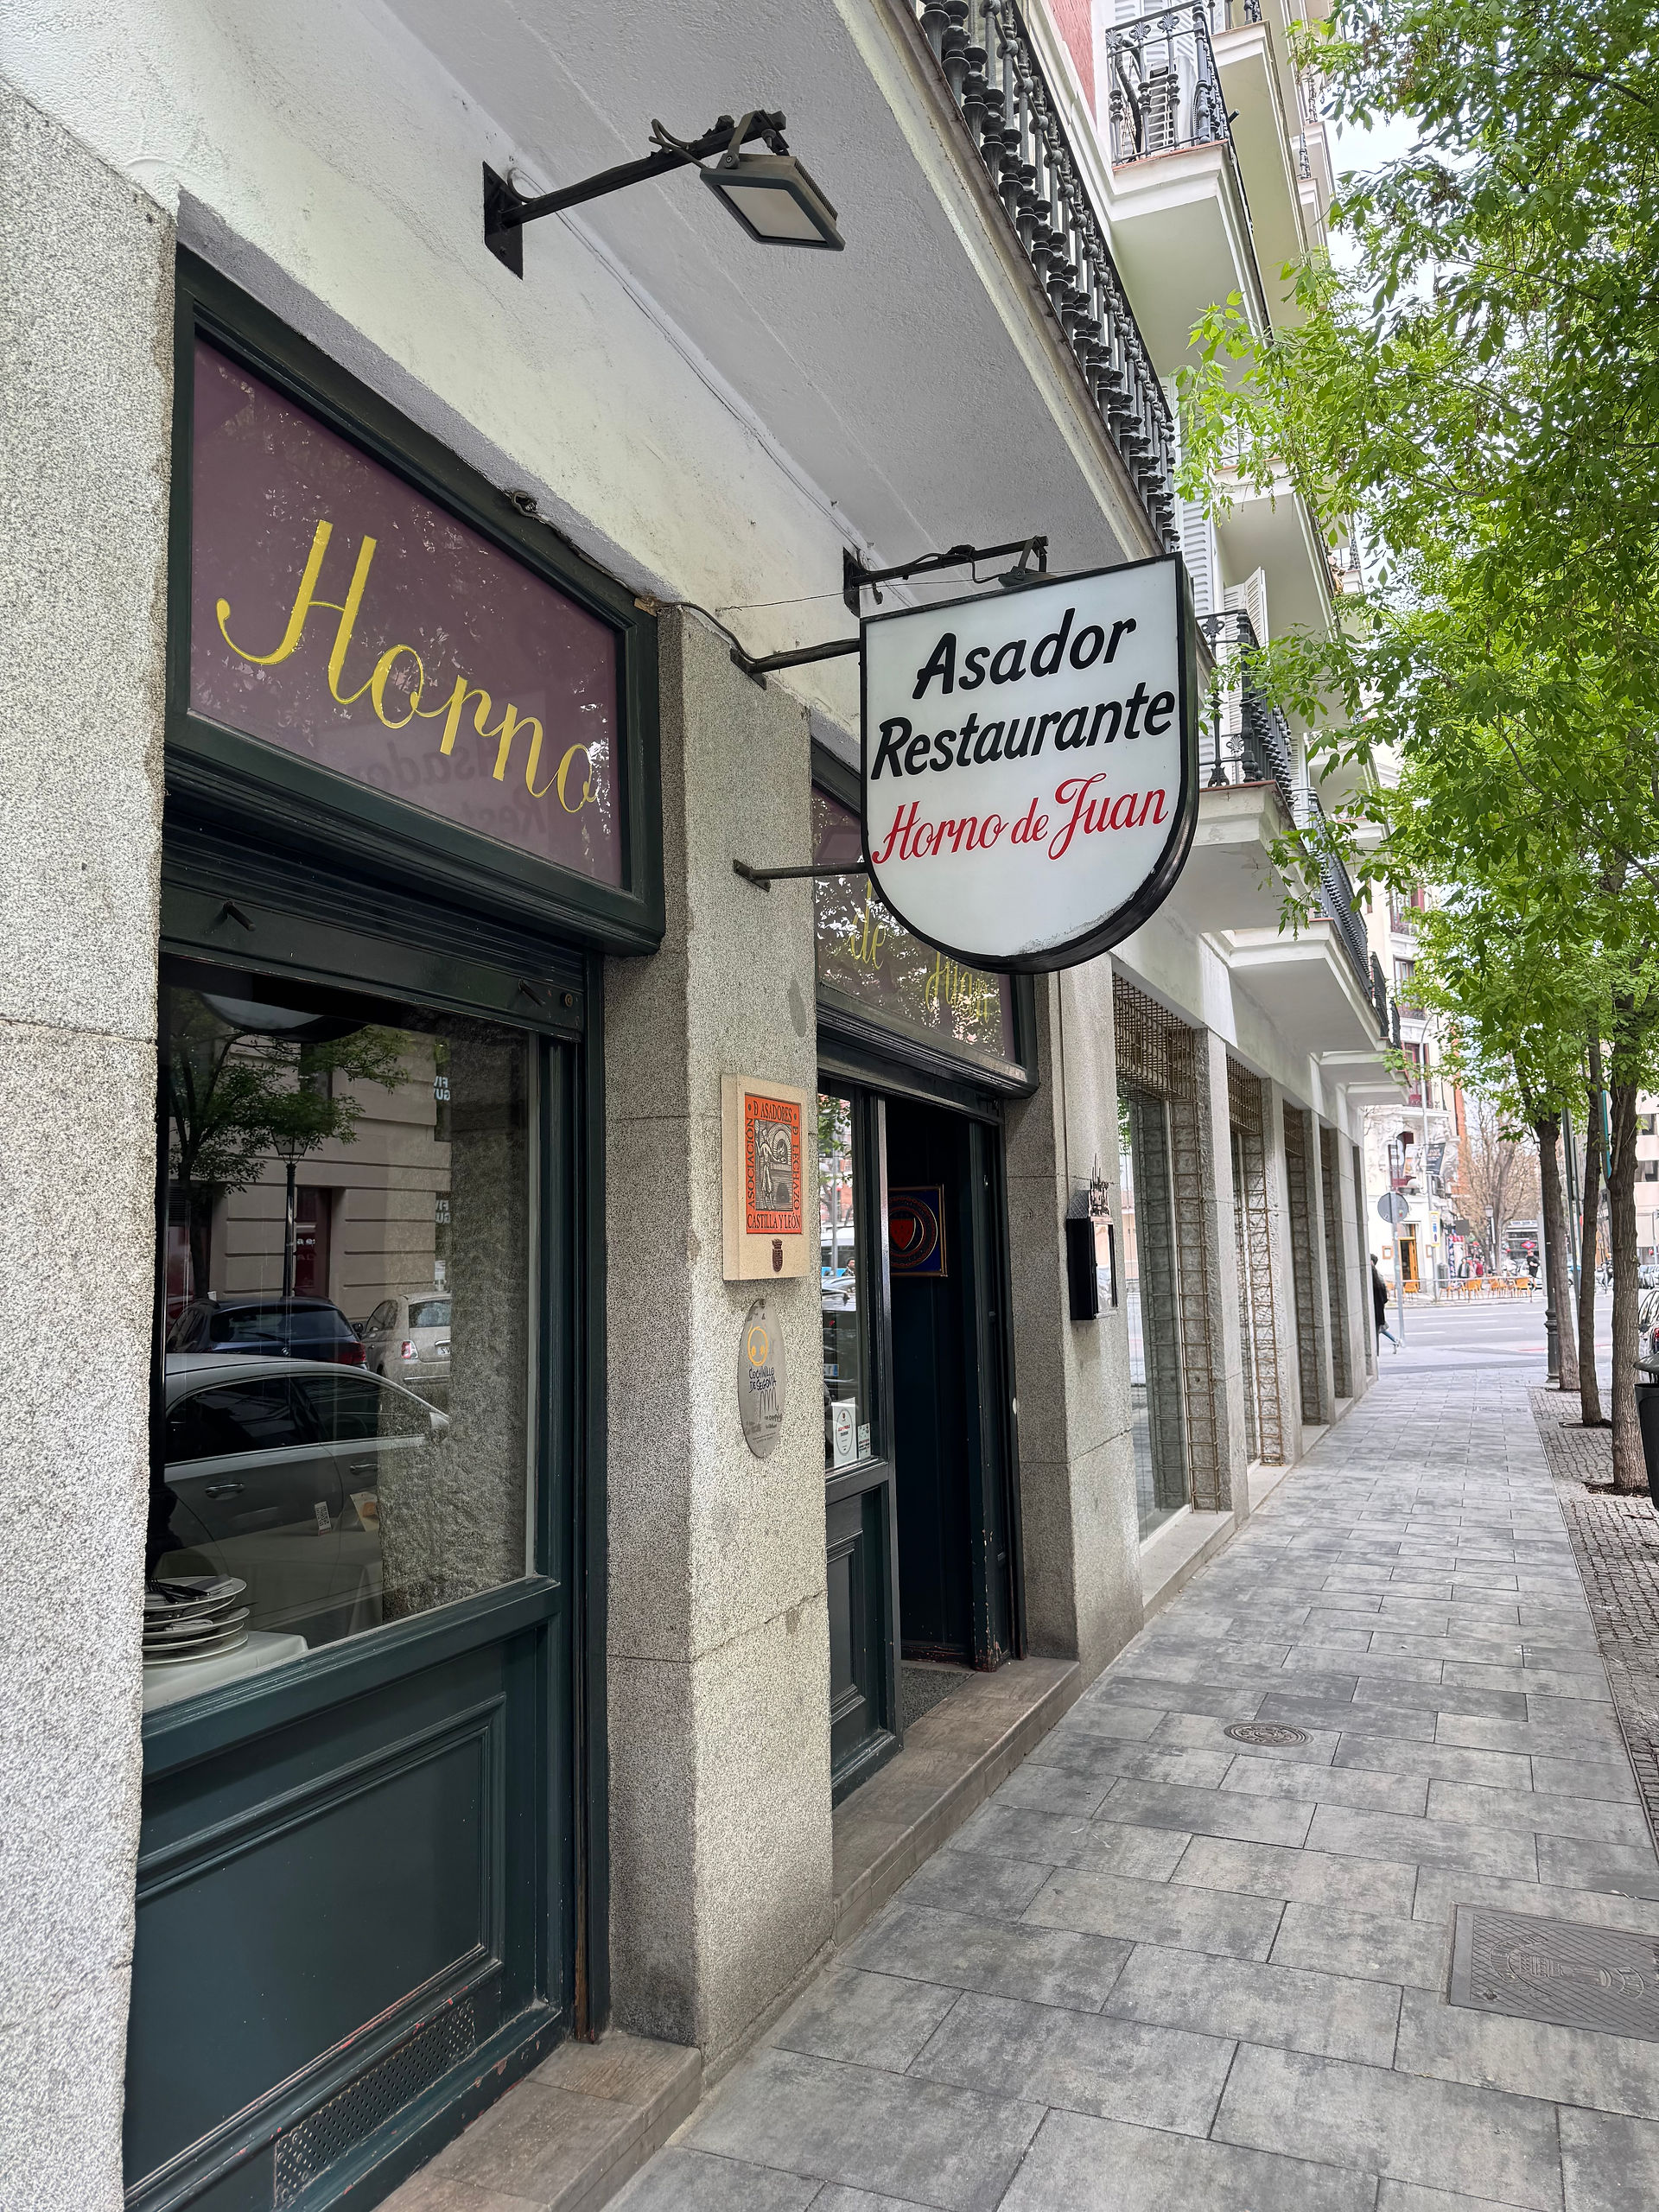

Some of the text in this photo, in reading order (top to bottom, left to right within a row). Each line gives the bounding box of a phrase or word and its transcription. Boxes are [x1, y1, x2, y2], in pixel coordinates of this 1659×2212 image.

[216, 519, 600, 813] Horno
[912, 608, 1136, 699] Asador
[871, 682, 1175, 779] Restaurante
[872, 772, 1169, 864] Horno de Juan
[842, 877, 990, 1024] de Juan
[760, 1102, 792, 1123] ASADORES
[746, 1117, 755, 1209] ASOCIACIÓN
[747, 1211, 801, 1229] CASTILLA Y LEÓN
